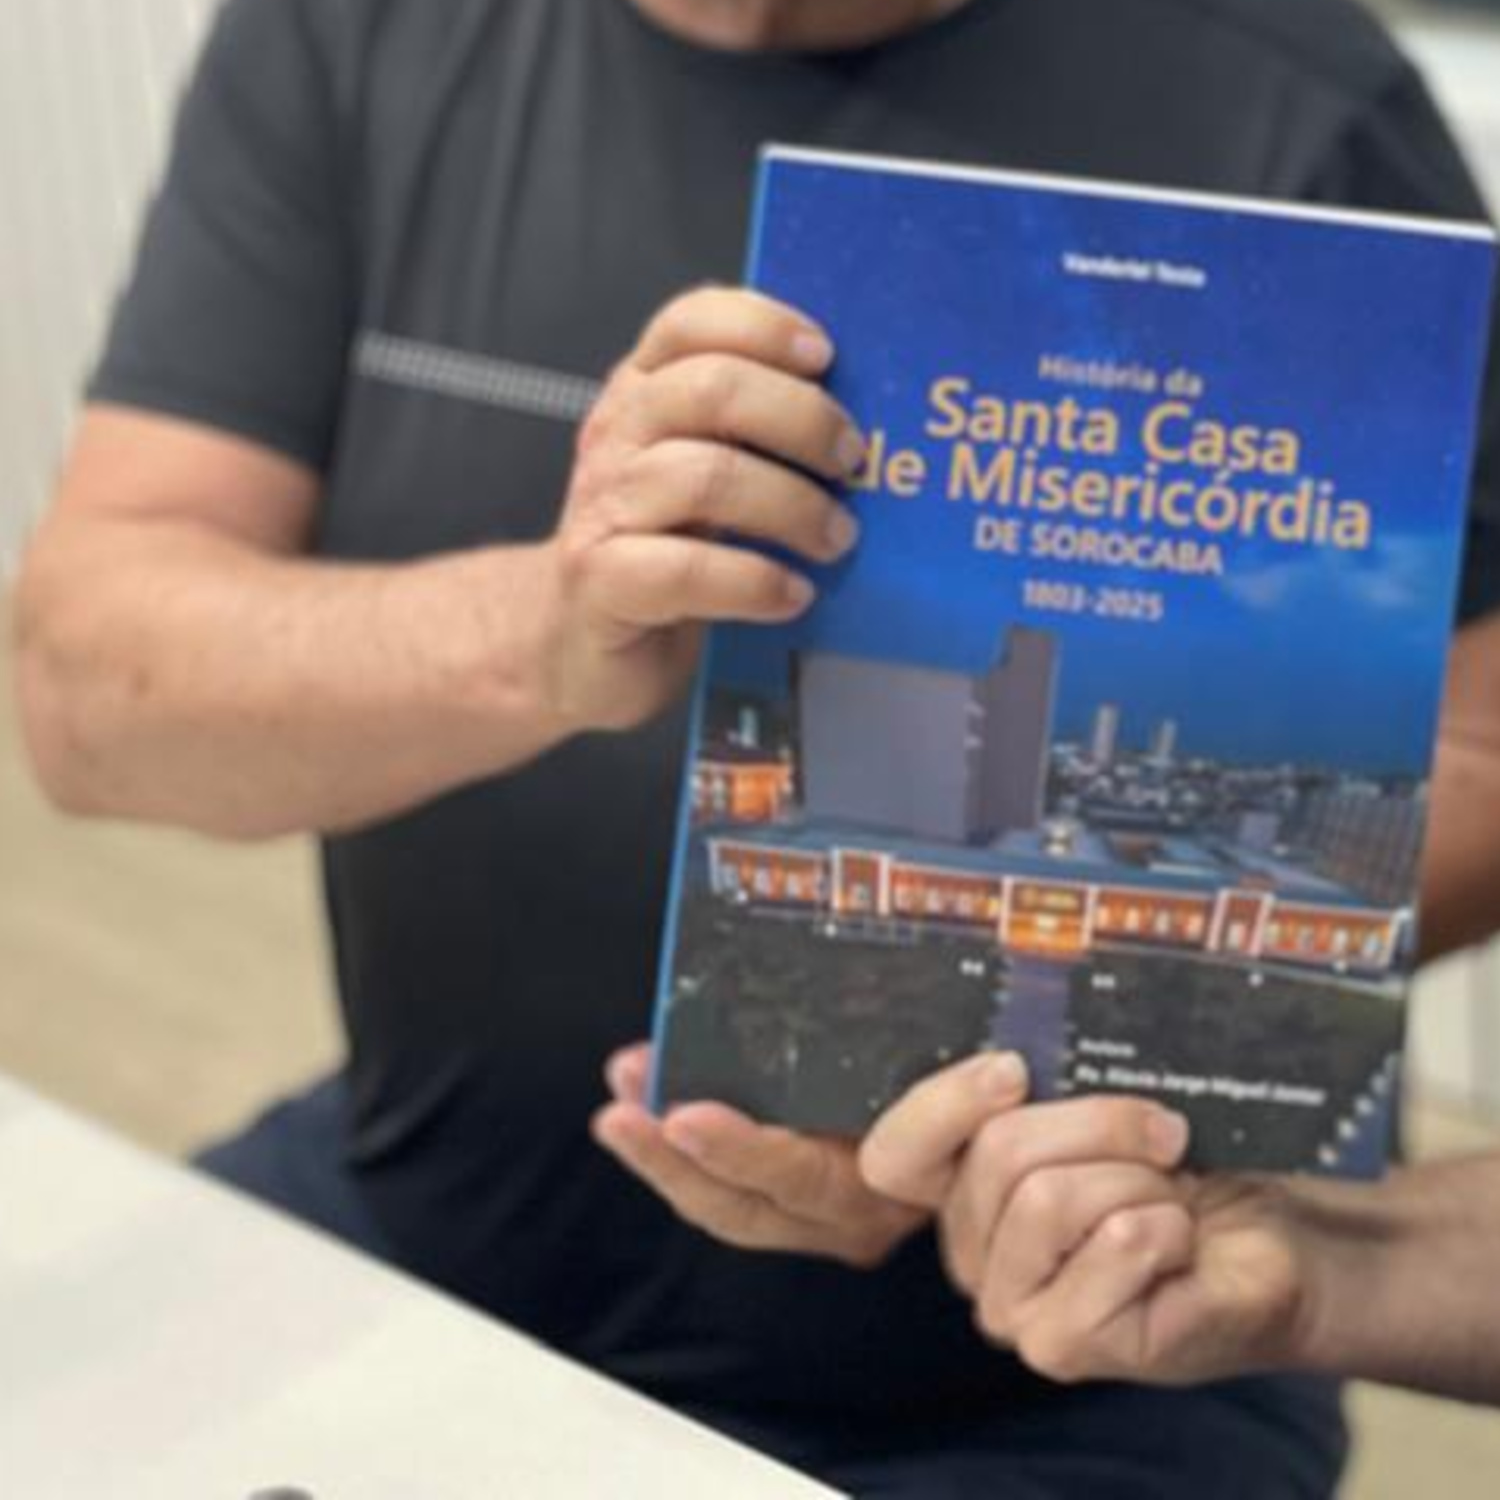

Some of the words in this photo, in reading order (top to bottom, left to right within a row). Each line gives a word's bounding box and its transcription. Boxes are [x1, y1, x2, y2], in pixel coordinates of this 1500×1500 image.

[1039, 354, 1156, 392] História
[1164, 368, 1203, 398] da
[926, 376, 1118, 455] Santa
[1142, 402, 1300, 475] Casa
[947, 441, 1372, 550] Misericórdia
[974, 516, 1021, 553] DE
[1030, 524, 1224, 576] SOROCABA
